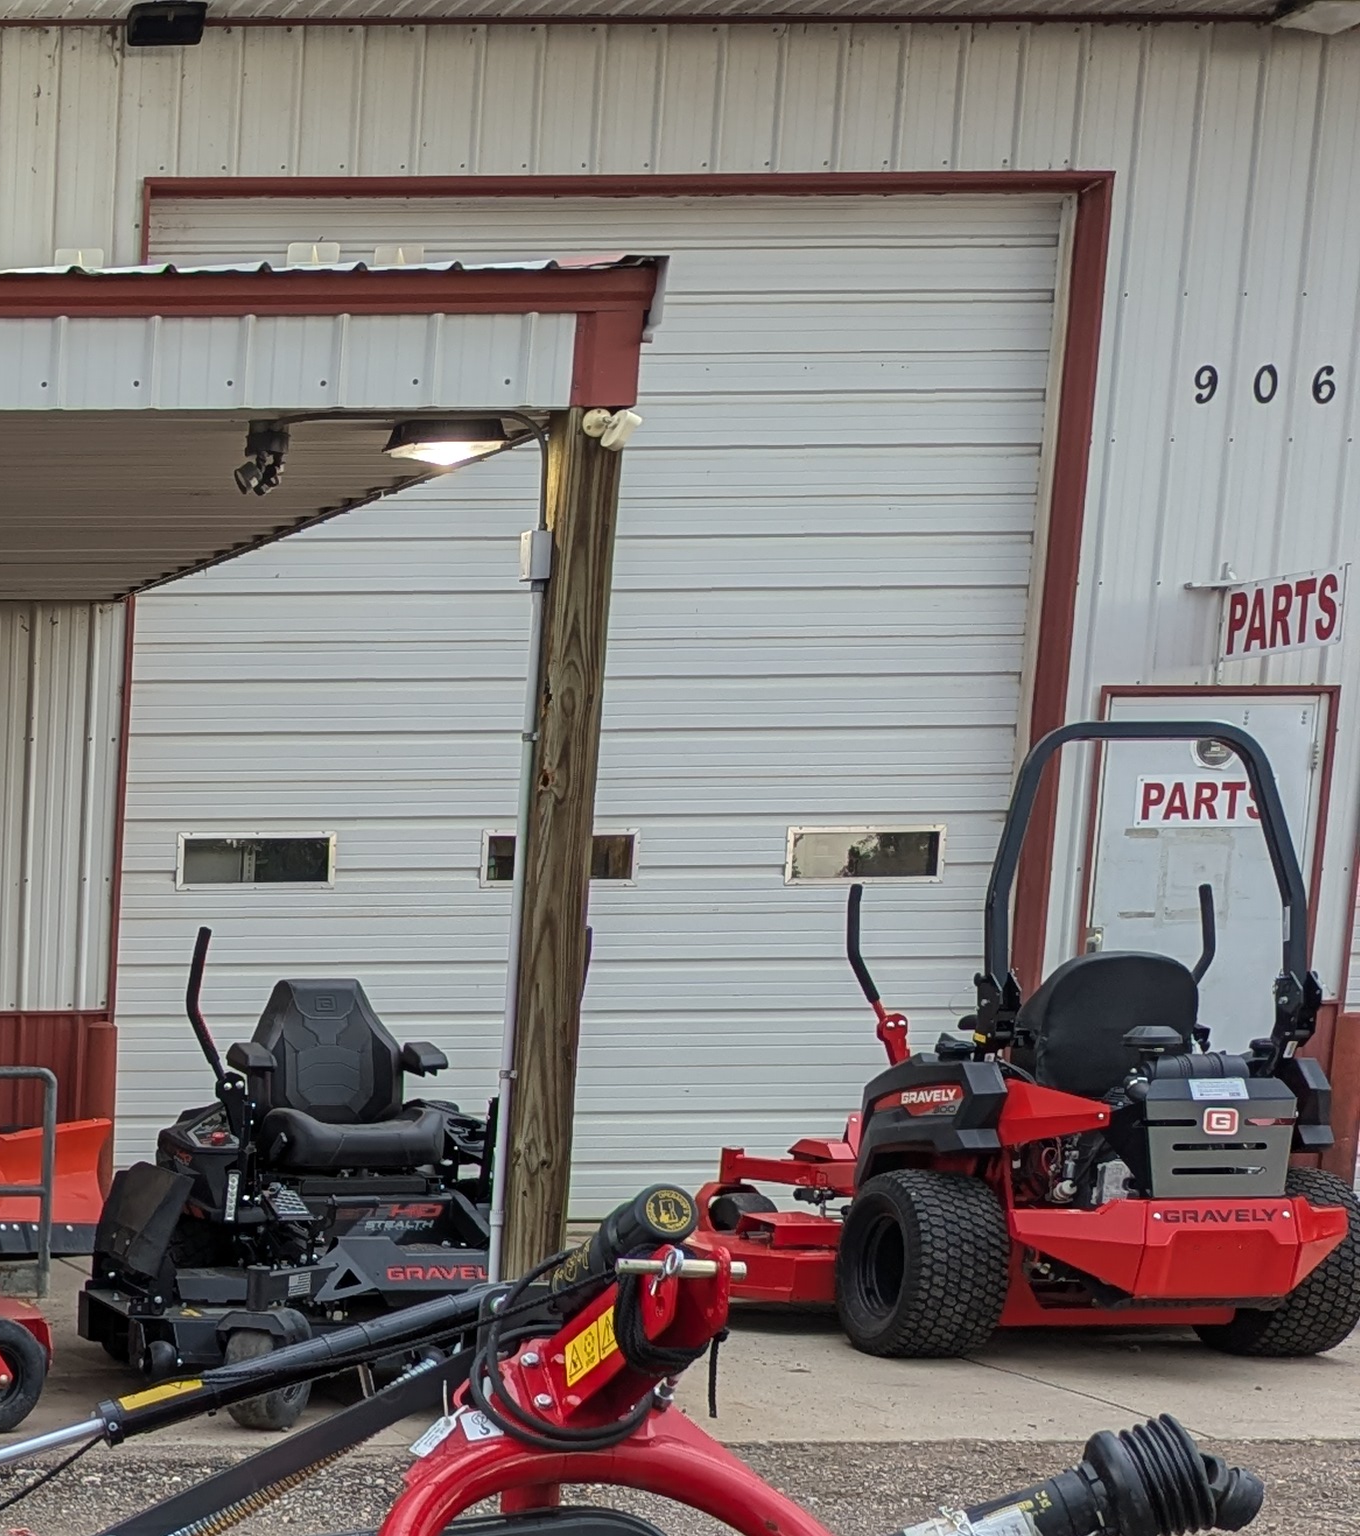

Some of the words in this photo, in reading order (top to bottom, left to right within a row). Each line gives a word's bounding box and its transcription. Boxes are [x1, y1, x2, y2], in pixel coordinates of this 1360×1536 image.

[1226, 573, 1338, 655] PARTS
[901, 1089, 957, 1105] GRAVELY
[1162, 1208, 1278, 1224] GRAVELY
[365, 1220, 434, 1230] STEALTH
[386, 1264, 489, 1281] GRAVEL
